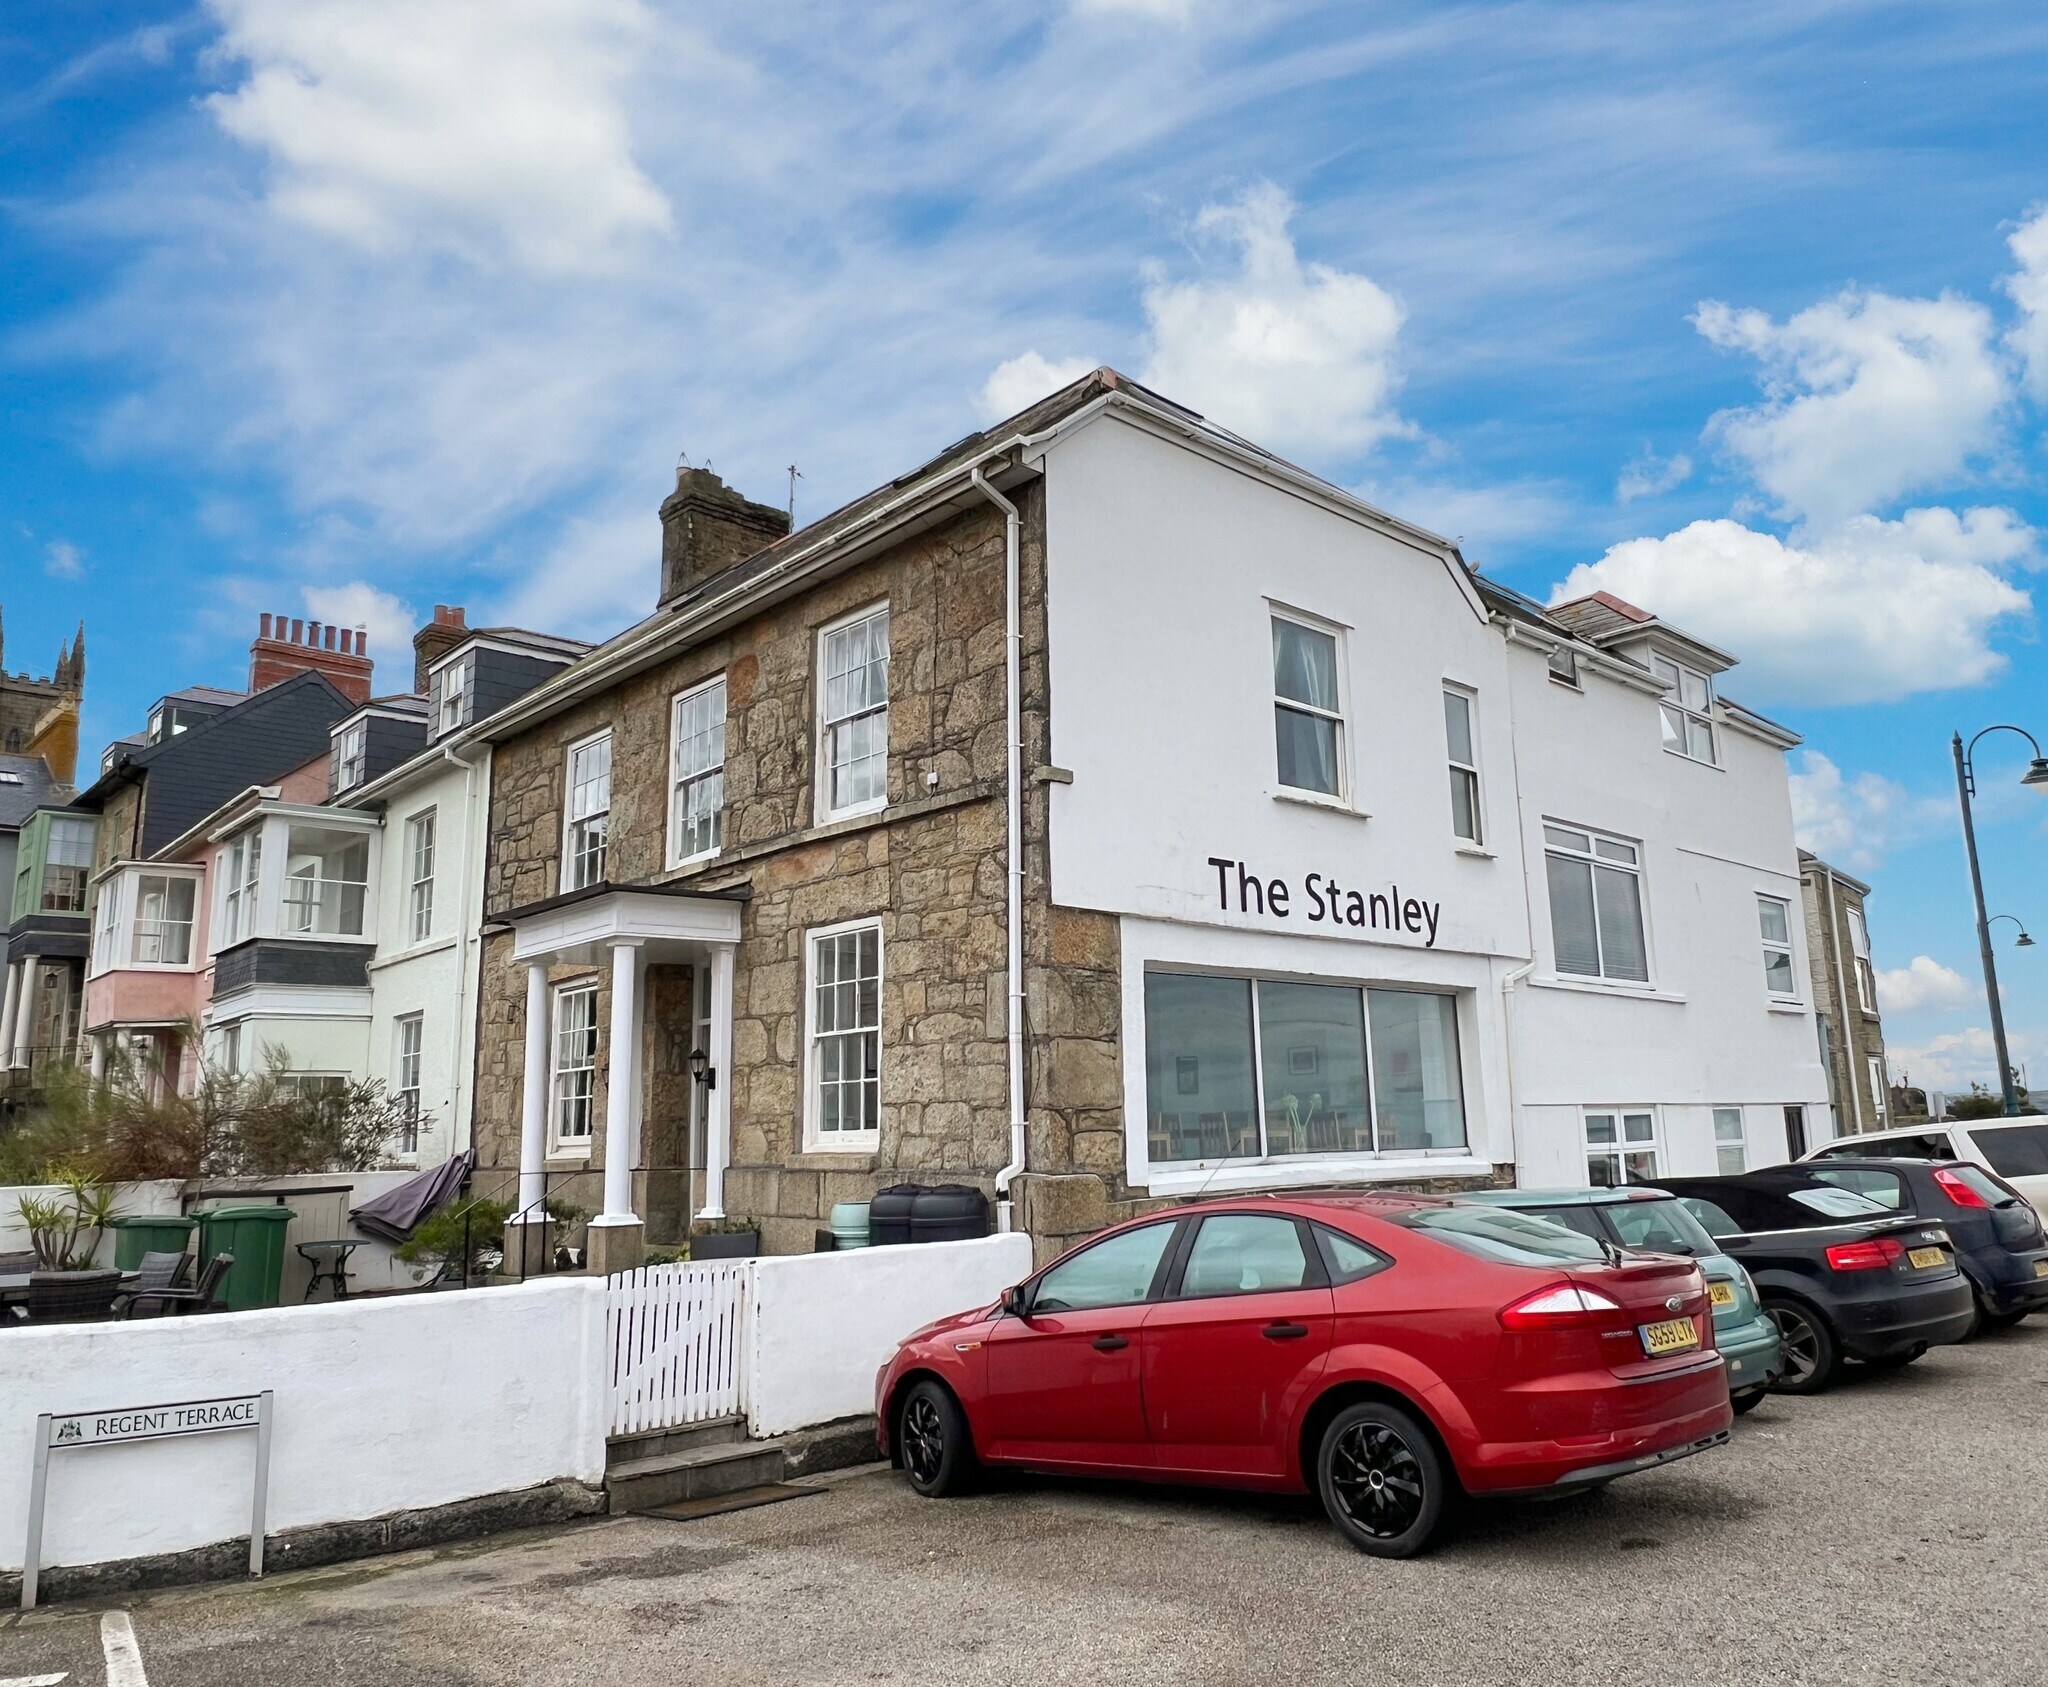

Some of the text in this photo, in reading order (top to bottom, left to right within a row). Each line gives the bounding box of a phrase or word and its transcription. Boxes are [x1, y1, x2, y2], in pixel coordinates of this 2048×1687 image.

[1208, 857, 1440, 948] The Stanley
[1647, 1324, 1676, 1347] SG59
[95, 1402, 254, 1436] REGENT TERRACE
